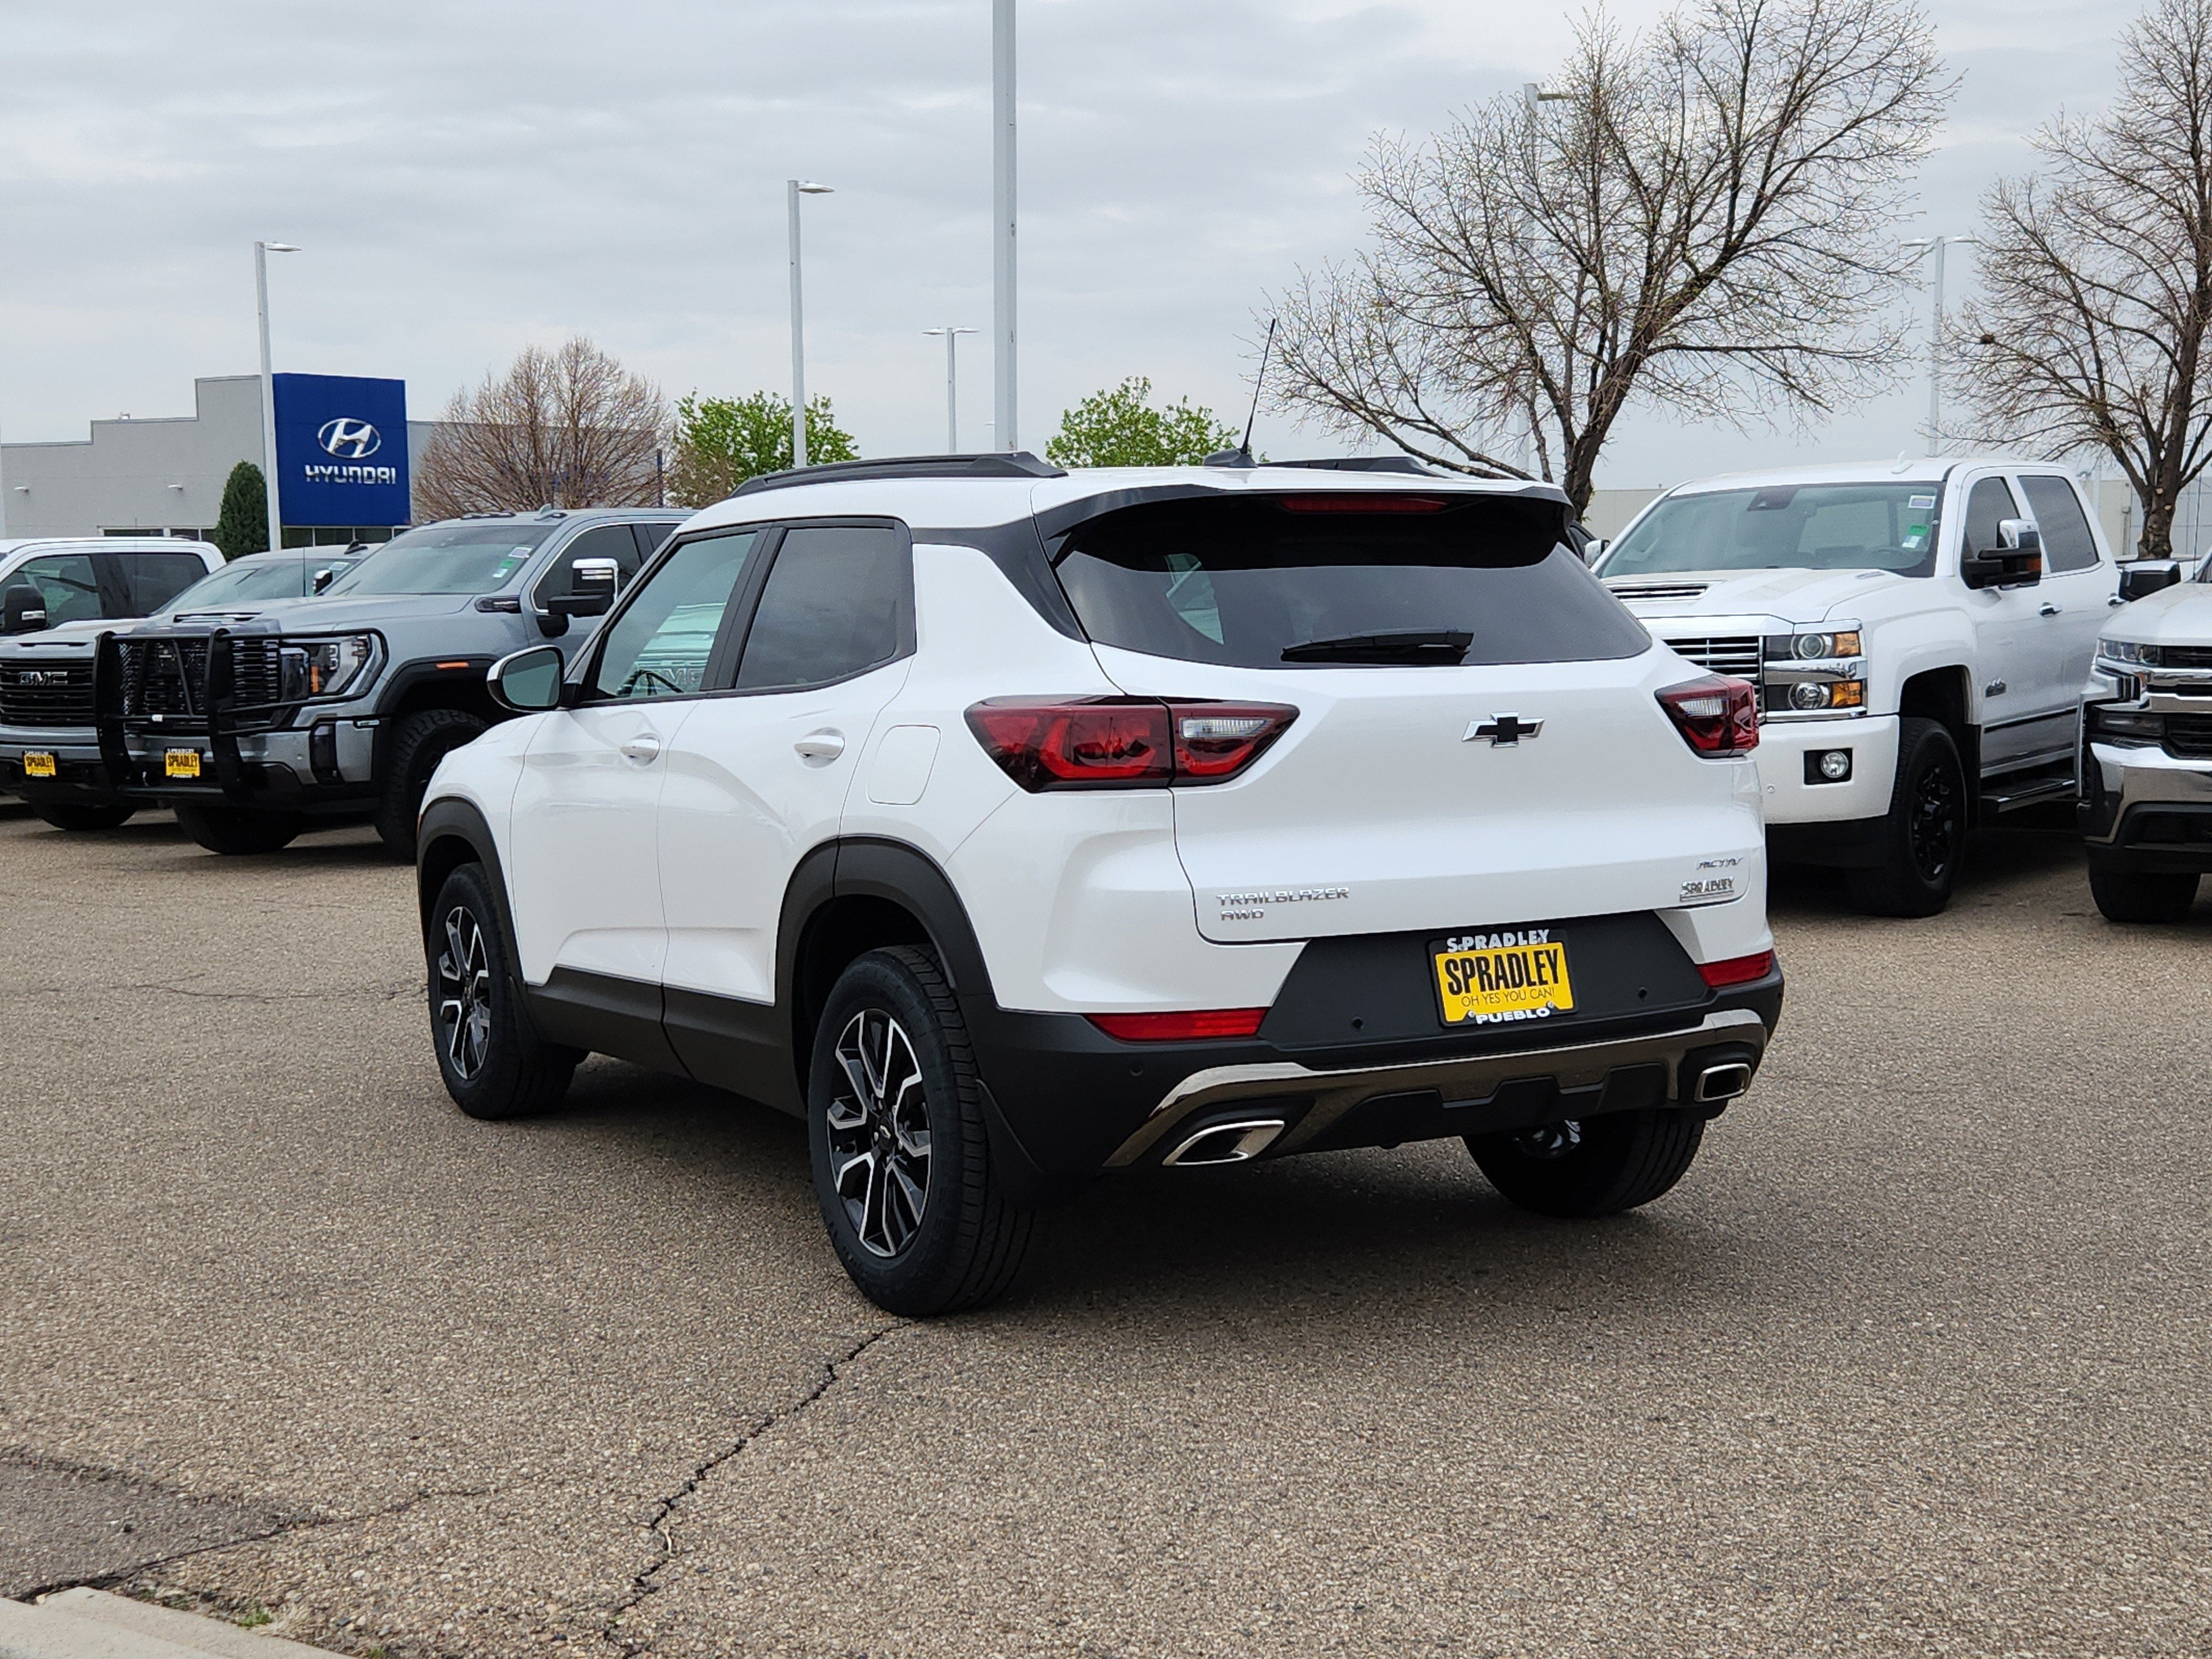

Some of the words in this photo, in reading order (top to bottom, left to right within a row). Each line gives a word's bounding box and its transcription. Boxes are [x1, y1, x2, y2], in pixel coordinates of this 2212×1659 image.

[305, 464, 396, 484] HYUNDAI
[18, 671, 68, 685] GMC
[1216, 887, 1349, 906] TRAILBLAZER
[1220, 908, 1264, 921] AWD
[1446, 929, 1549, 953] SPRADLEY
[1444, 949, 1559, 996] SPRADLEY
[1461, 994, 1480, 1007] OH
[1482, 992, 1501, 1005] YES
[1503, 989, 1527, 1002] YOU
[1529, 987, 1555, 1000] CAN!
[1475, 1007, 1551, 1025] PUEBLO
